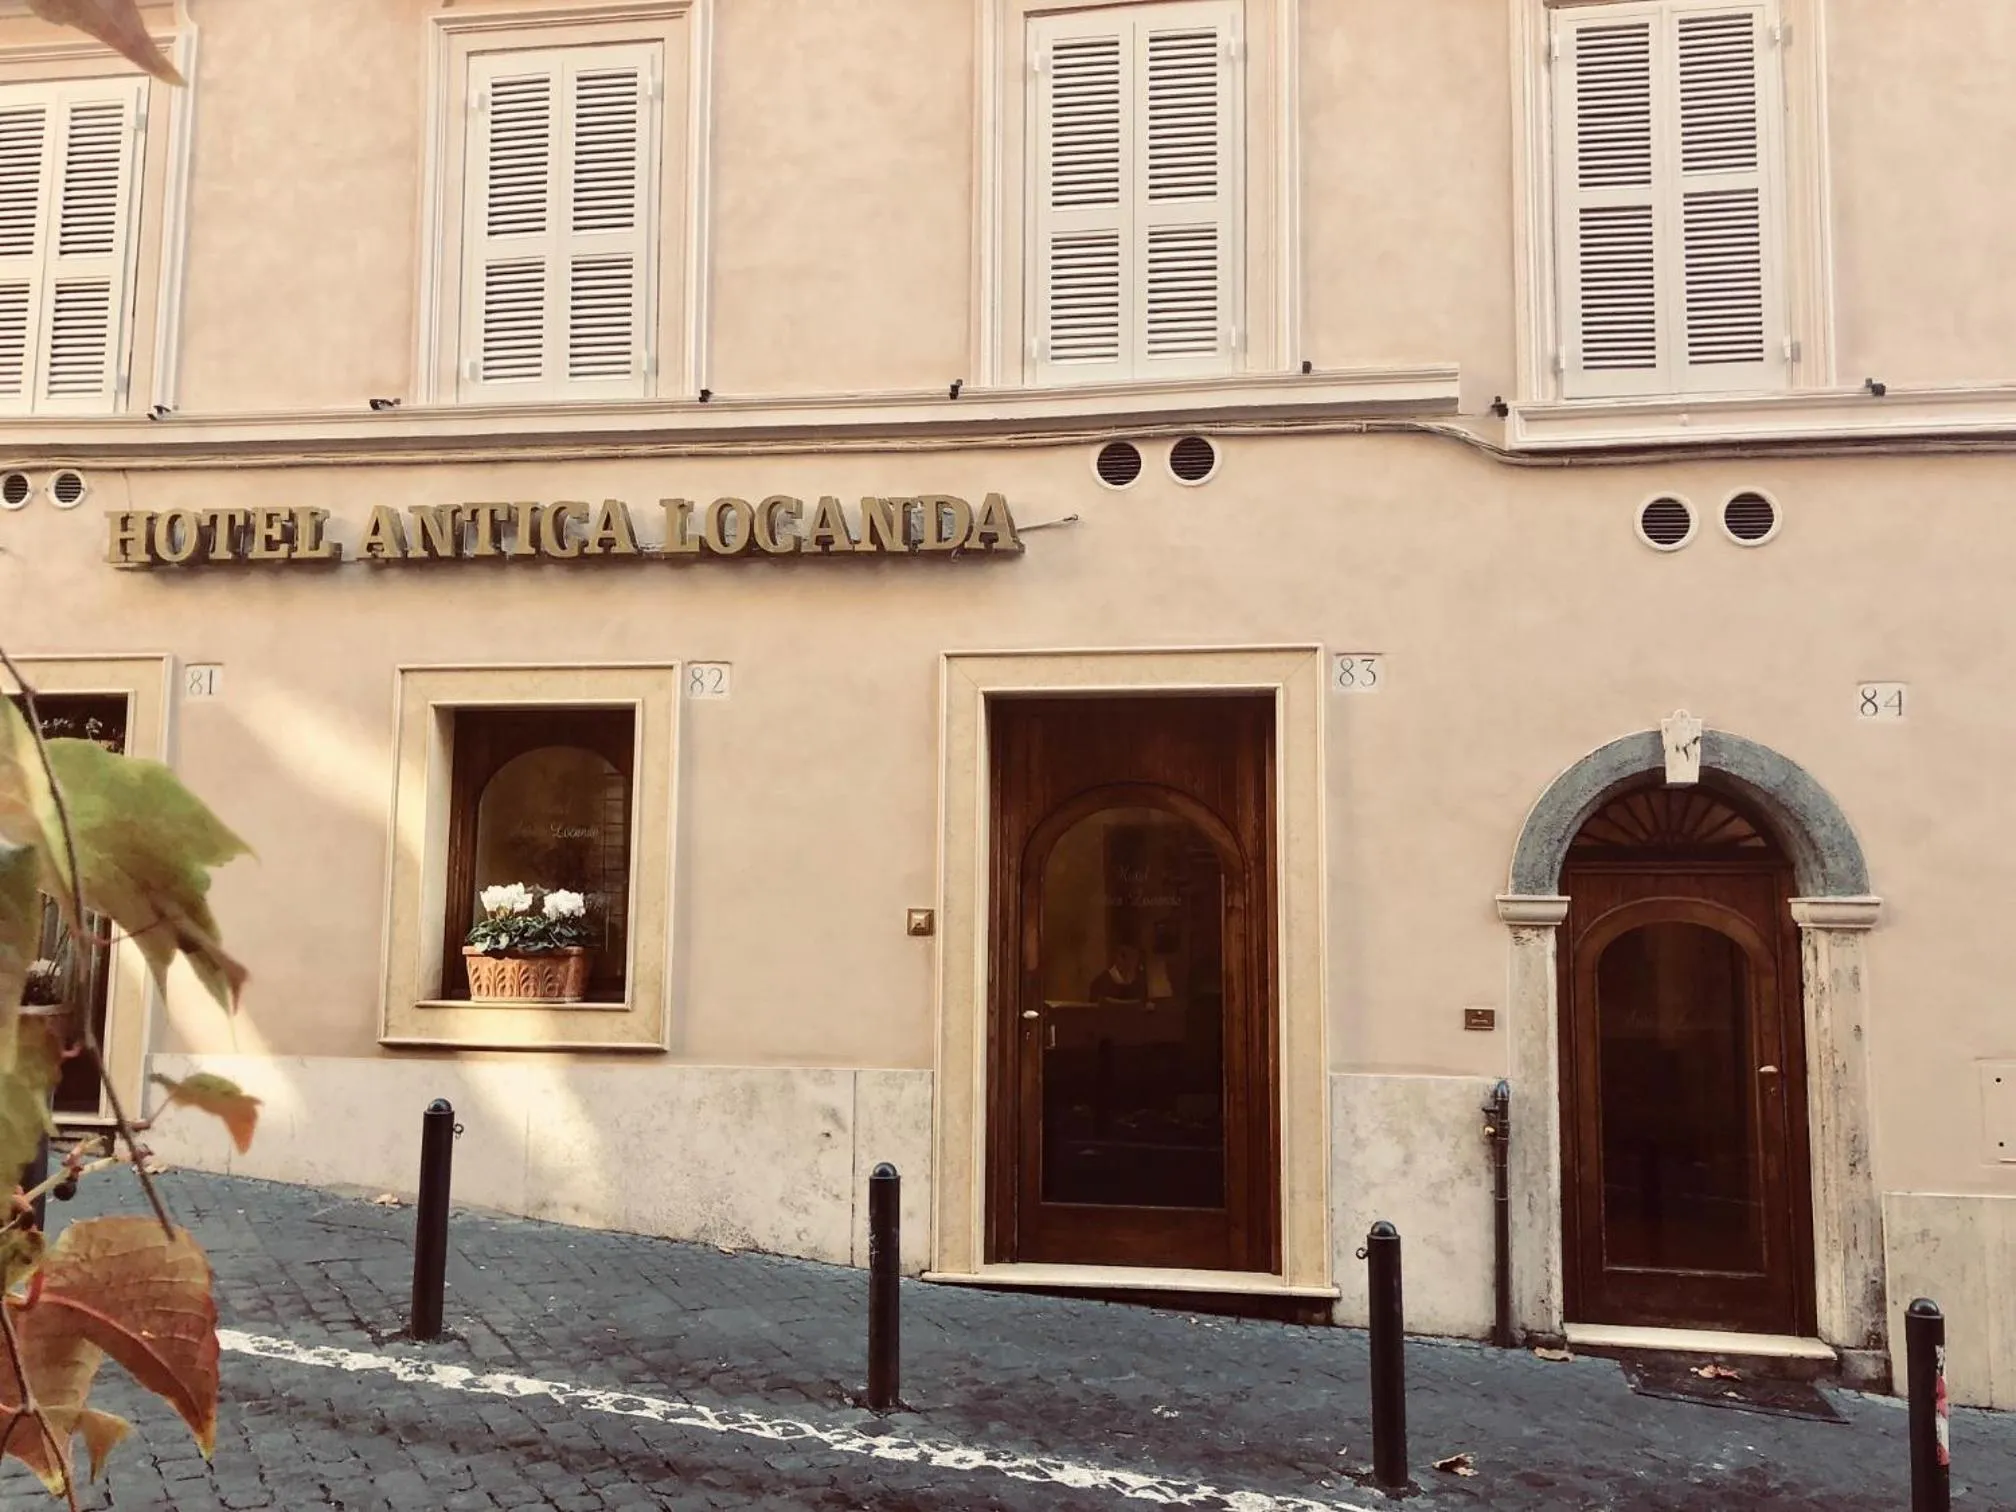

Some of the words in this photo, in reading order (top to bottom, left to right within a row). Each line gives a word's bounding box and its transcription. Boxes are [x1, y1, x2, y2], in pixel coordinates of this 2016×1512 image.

[103, 506, 340, 564] HOTEL
[356, 499, 638, 561] ANTICA
[659, 493, 1023, 554] LOCANDA
[189, 669, 214, 696] 81
[690, 667, 724, 697] 82
[1339, 658, 1376, 687] 83
[1860, 687, 1902, 716] 84
